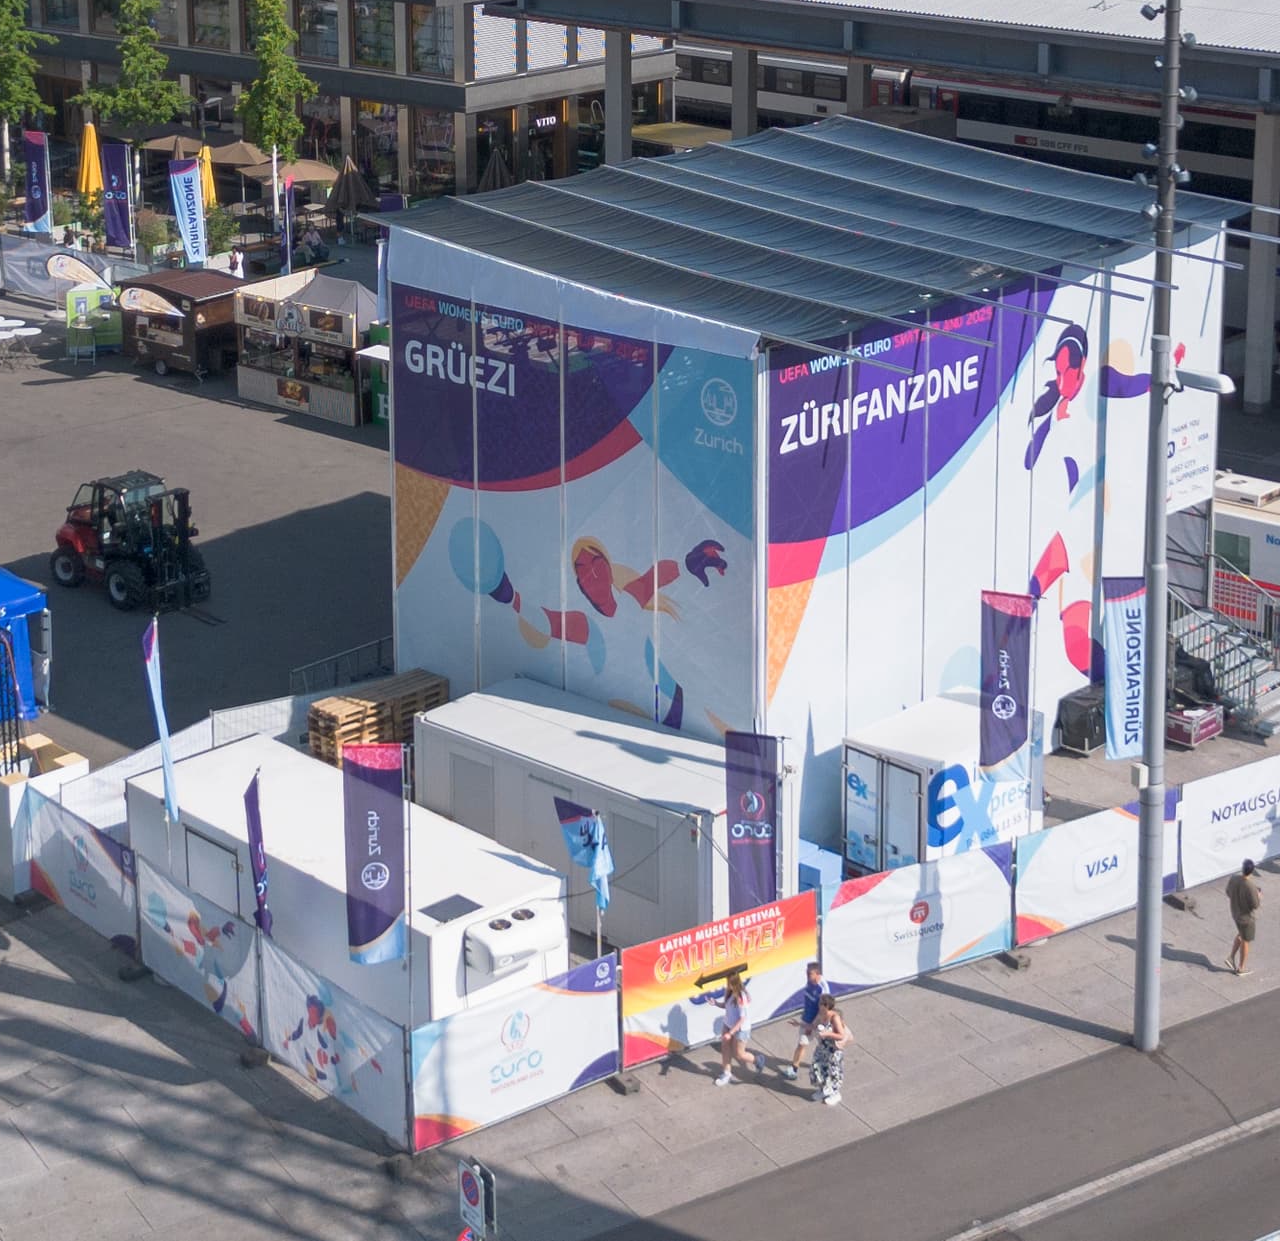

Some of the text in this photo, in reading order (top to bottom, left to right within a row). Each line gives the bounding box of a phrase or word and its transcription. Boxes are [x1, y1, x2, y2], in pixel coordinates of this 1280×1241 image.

[536, 116, 557, 128] VITO
[404, 295, 436, 312] UEFA
[438, 300, 489, 326] WOMEN'S
[491, 314, 524, 332] EURO
[778, 363, 809, 385] UEFA
[809, 344, 862, 374] WOM'S
[863, 337, 891, 358] EURO
[966, 306, 993, 324] 2025
[404, 339, 516, 397] GRÜEZI
[779, 355, 979, 455] ZÜRIFANZONE
[695, 427, 744, 455] Zurich
[1086, 854, 1119, 878] VISA
[654, 917, 785, 984] CALIENTE!
[660, 906, 781, 953] LATIN MUSIC FESTIVAL
[893, 921, 945, 943] Swissquote
